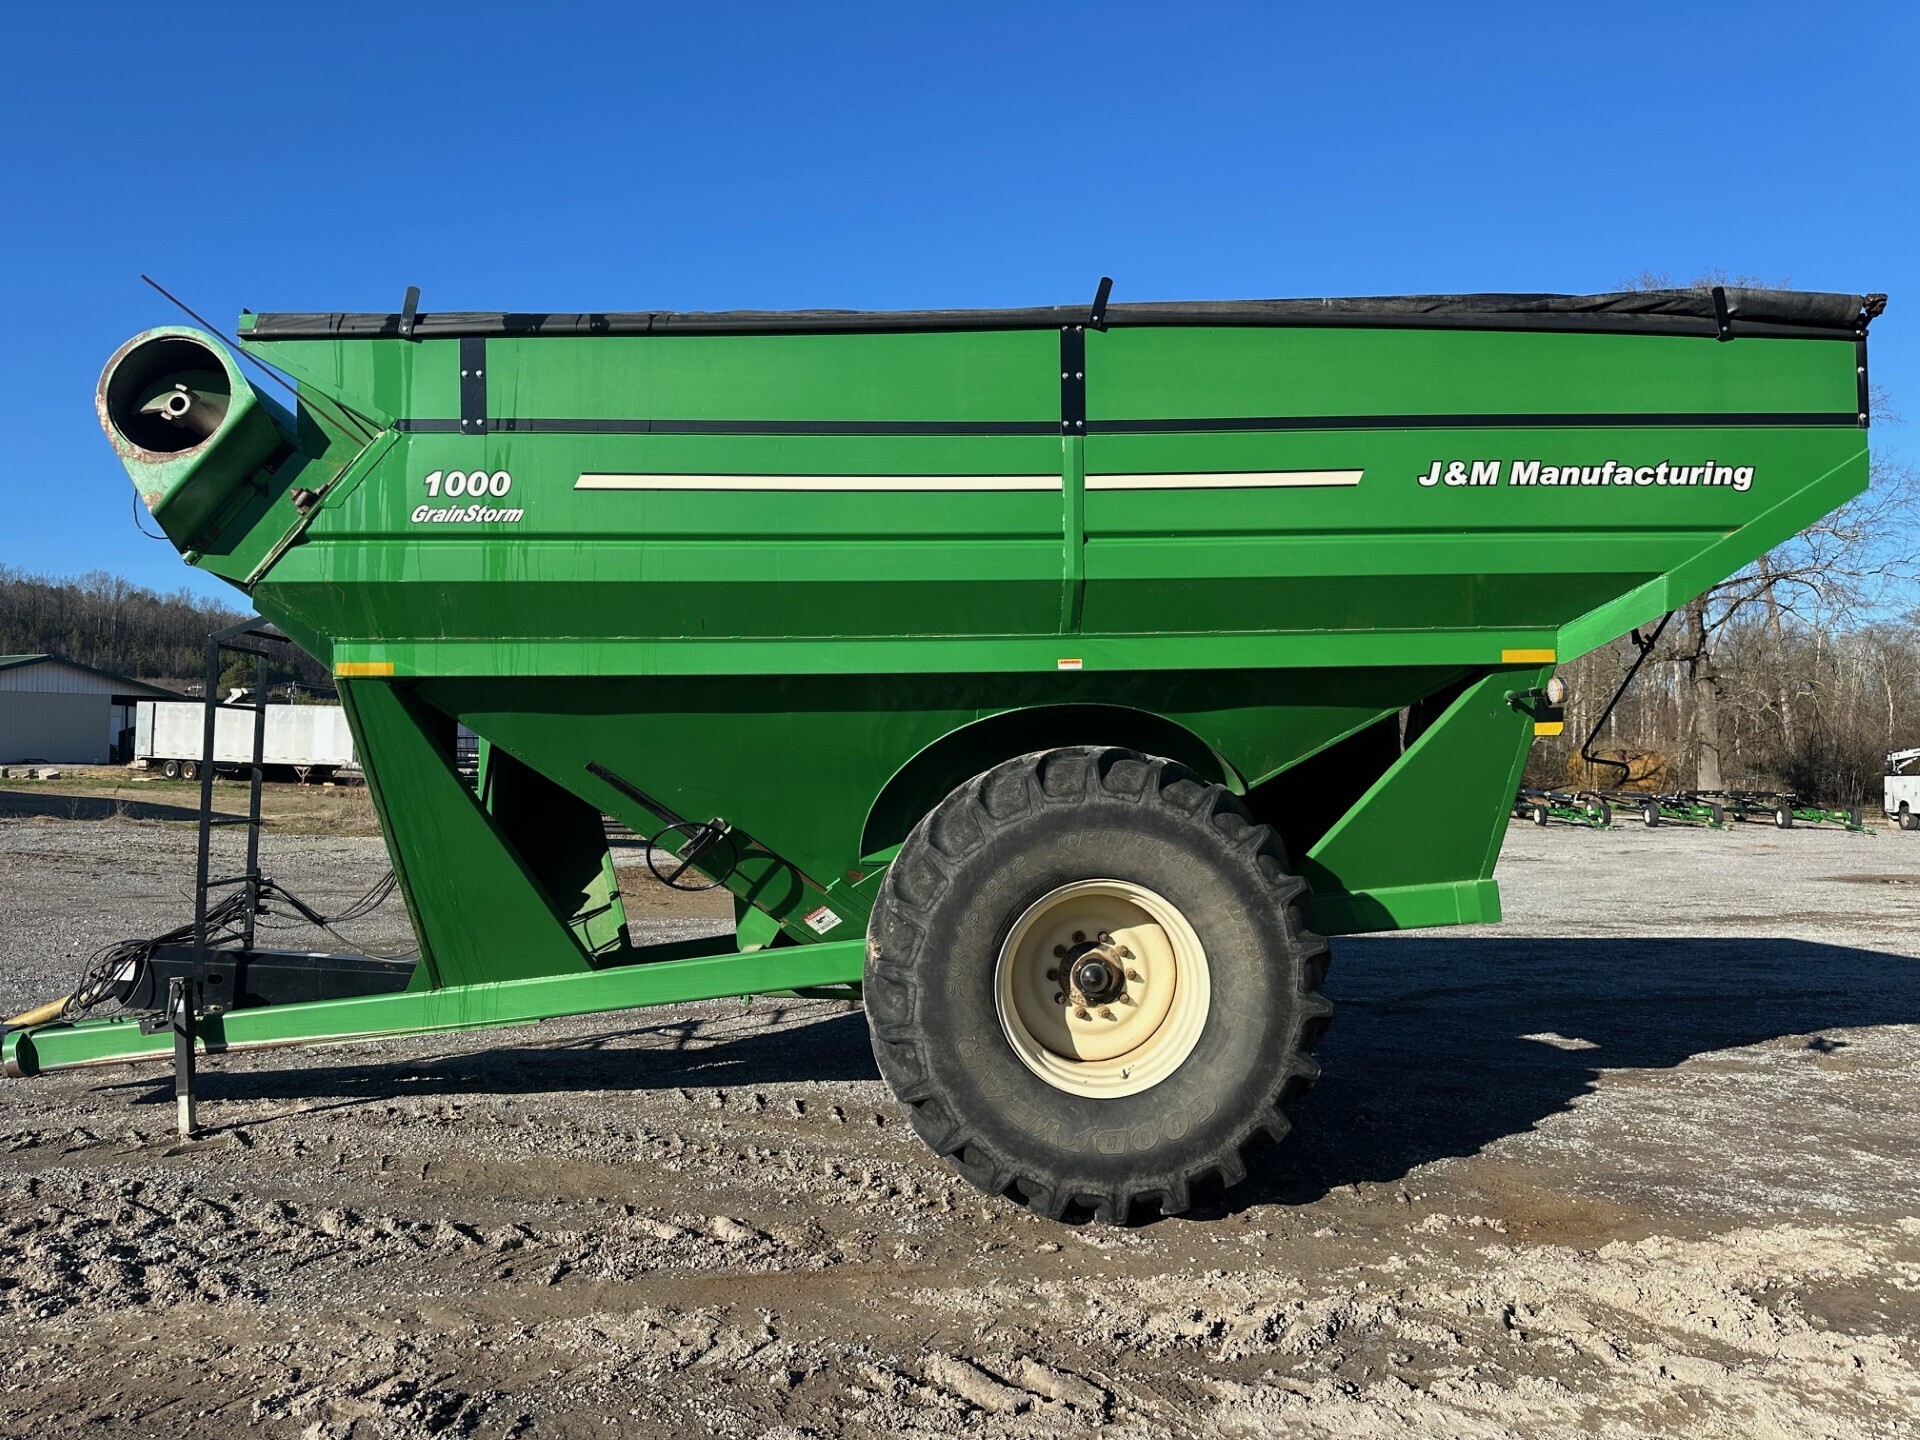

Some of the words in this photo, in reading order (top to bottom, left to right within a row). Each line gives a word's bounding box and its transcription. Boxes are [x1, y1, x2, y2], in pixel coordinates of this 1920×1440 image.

[424, 470, 512, 498] 1000
[1417, 460, 1501, 487] J&M
[1508, 459, 1755, 492] Manufacturing
[411, 504, 525, 523] GrainStorm
[1057, 829, 1216, 882] OPTITRAC
[947, 855, 1026, 998] 900/60R32
[956, 1036, 1217, 1155] GOODYEAR
